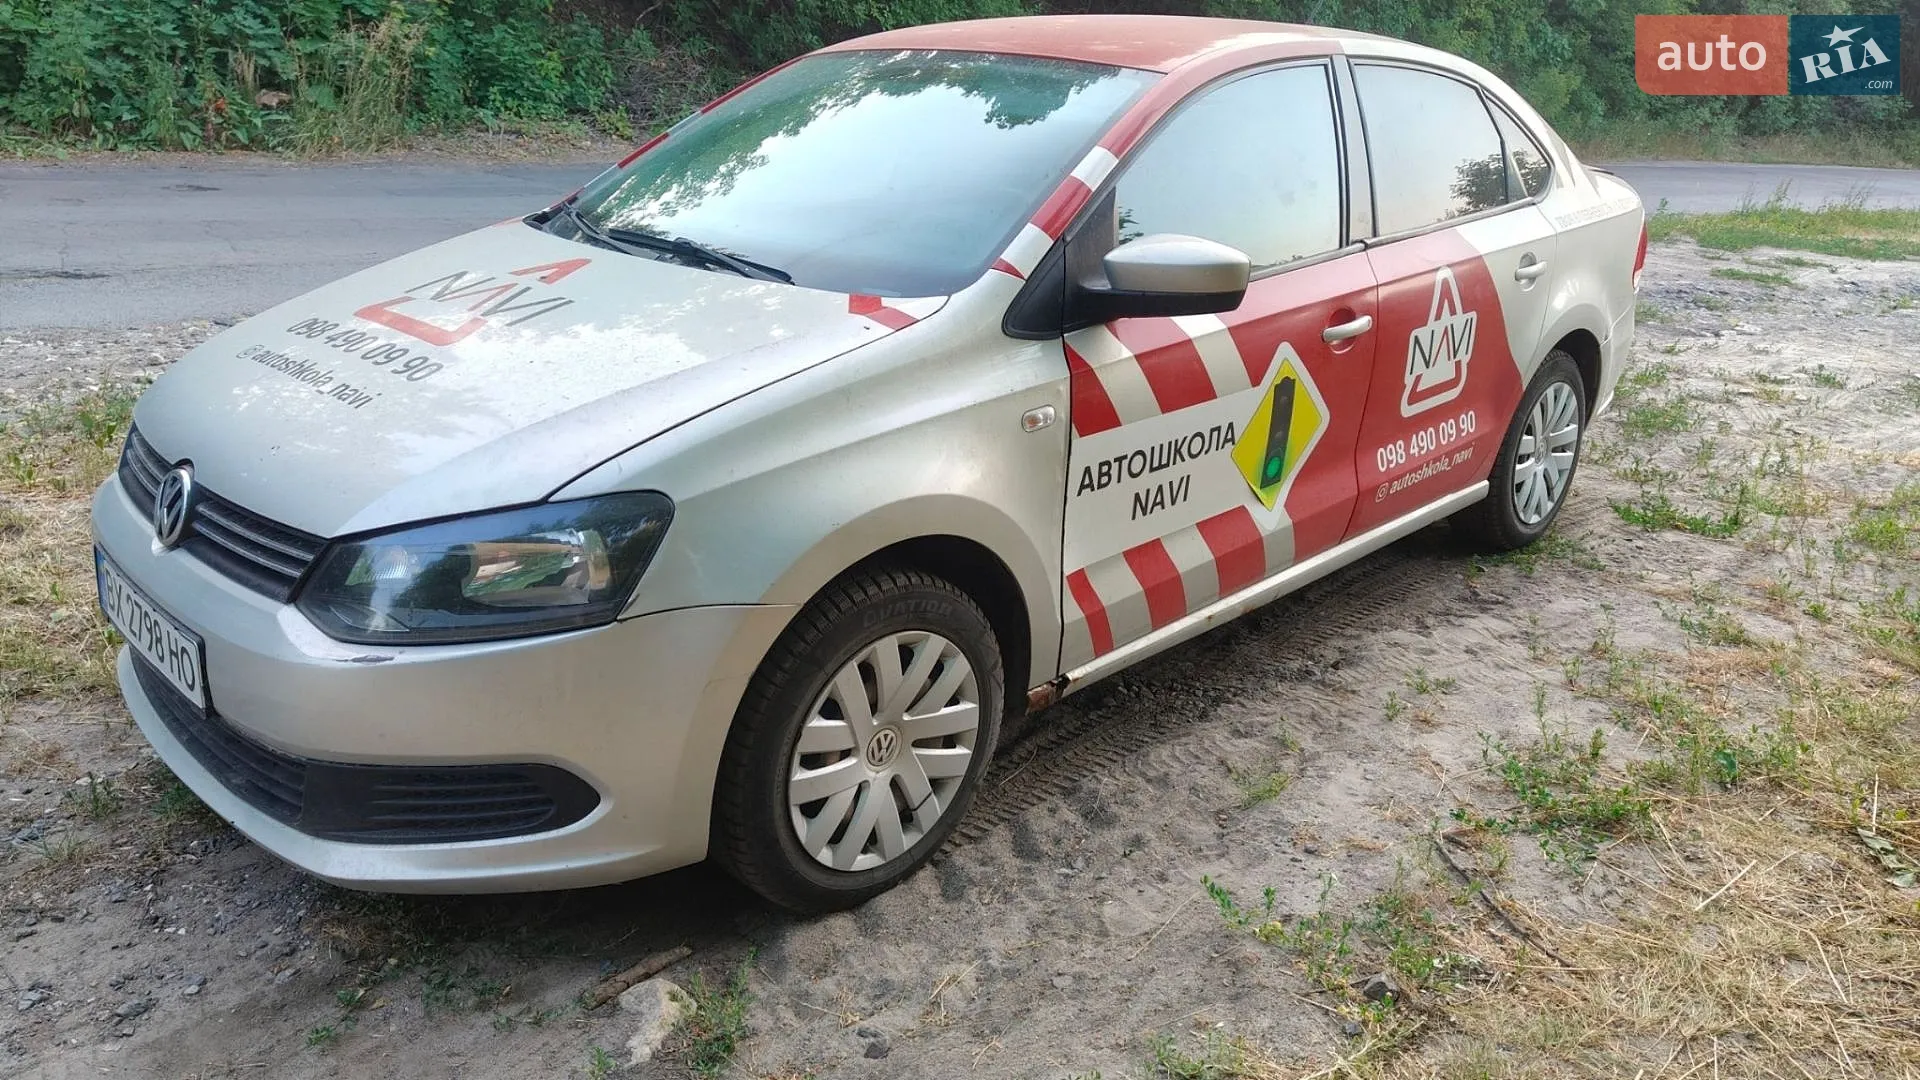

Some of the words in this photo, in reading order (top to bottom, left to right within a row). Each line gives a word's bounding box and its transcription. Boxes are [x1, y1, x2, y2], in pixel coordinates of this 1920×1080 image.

[404, 270, 575, 327] NAVI
[286, 317, 340, 339] 098
[324, 329, 379, 353] 490
[360, 342, 410, 366] 09
[391, 355, 444, 382] 90
[1409, 317, 1473, 376] NAVI
[251, 347, 382, 409] autoshkola_navi
[1076, 421, 1236, 497] АВТОШКОЛА
[1377, 439, 1406, 473] 098
[1410, 427, 1436, 457] 490
[1439, 418, 1456, 445] 09
[1459, 410, 1475, 437] 90
[1389, 441, 1476, 495] autoshkola_navi
[1131, 474, 1191, 520] NAVI
[105, 567, 126, 627] BX
[126, 593, 165, 664] 2798
[167, 629, 196, 692] HO
